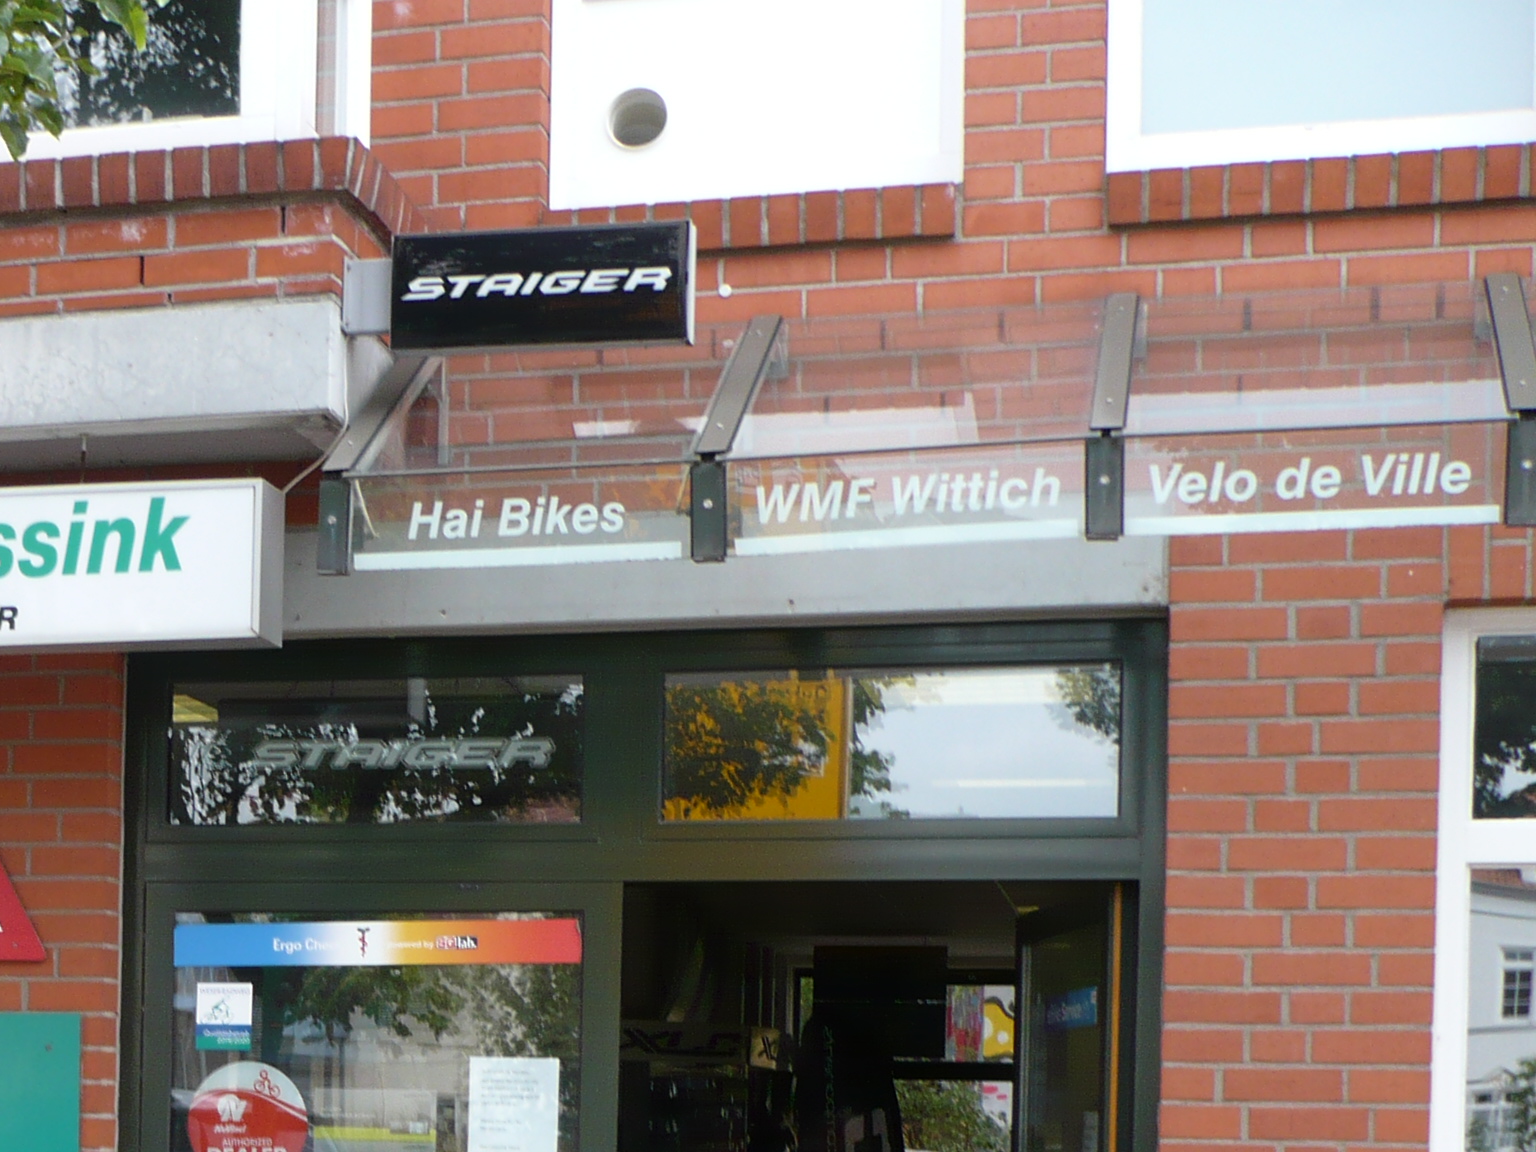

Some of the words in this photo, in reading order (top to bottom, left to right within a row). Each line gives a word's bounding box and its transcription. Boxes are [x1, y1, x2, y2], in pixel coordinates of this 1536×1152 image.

[401, 266, 672, 301] STAIGER
[1149, 461, 1258, 504] Velo
[1276, 457, 1342, 500] de
[1361, 452, 1472, 496] Ville
[755, 478, 878, 525] WMF
[891, 468, 1061, 514] Wittich
[408, 500, 484, 540] Hai
[498, 495, 626, 536] Bikes
[251, 736, 556, 770] STAIGER
[272, 938, 302, 954] Ergo
[222, 1137, 273, 1147] AUTHORIZED
